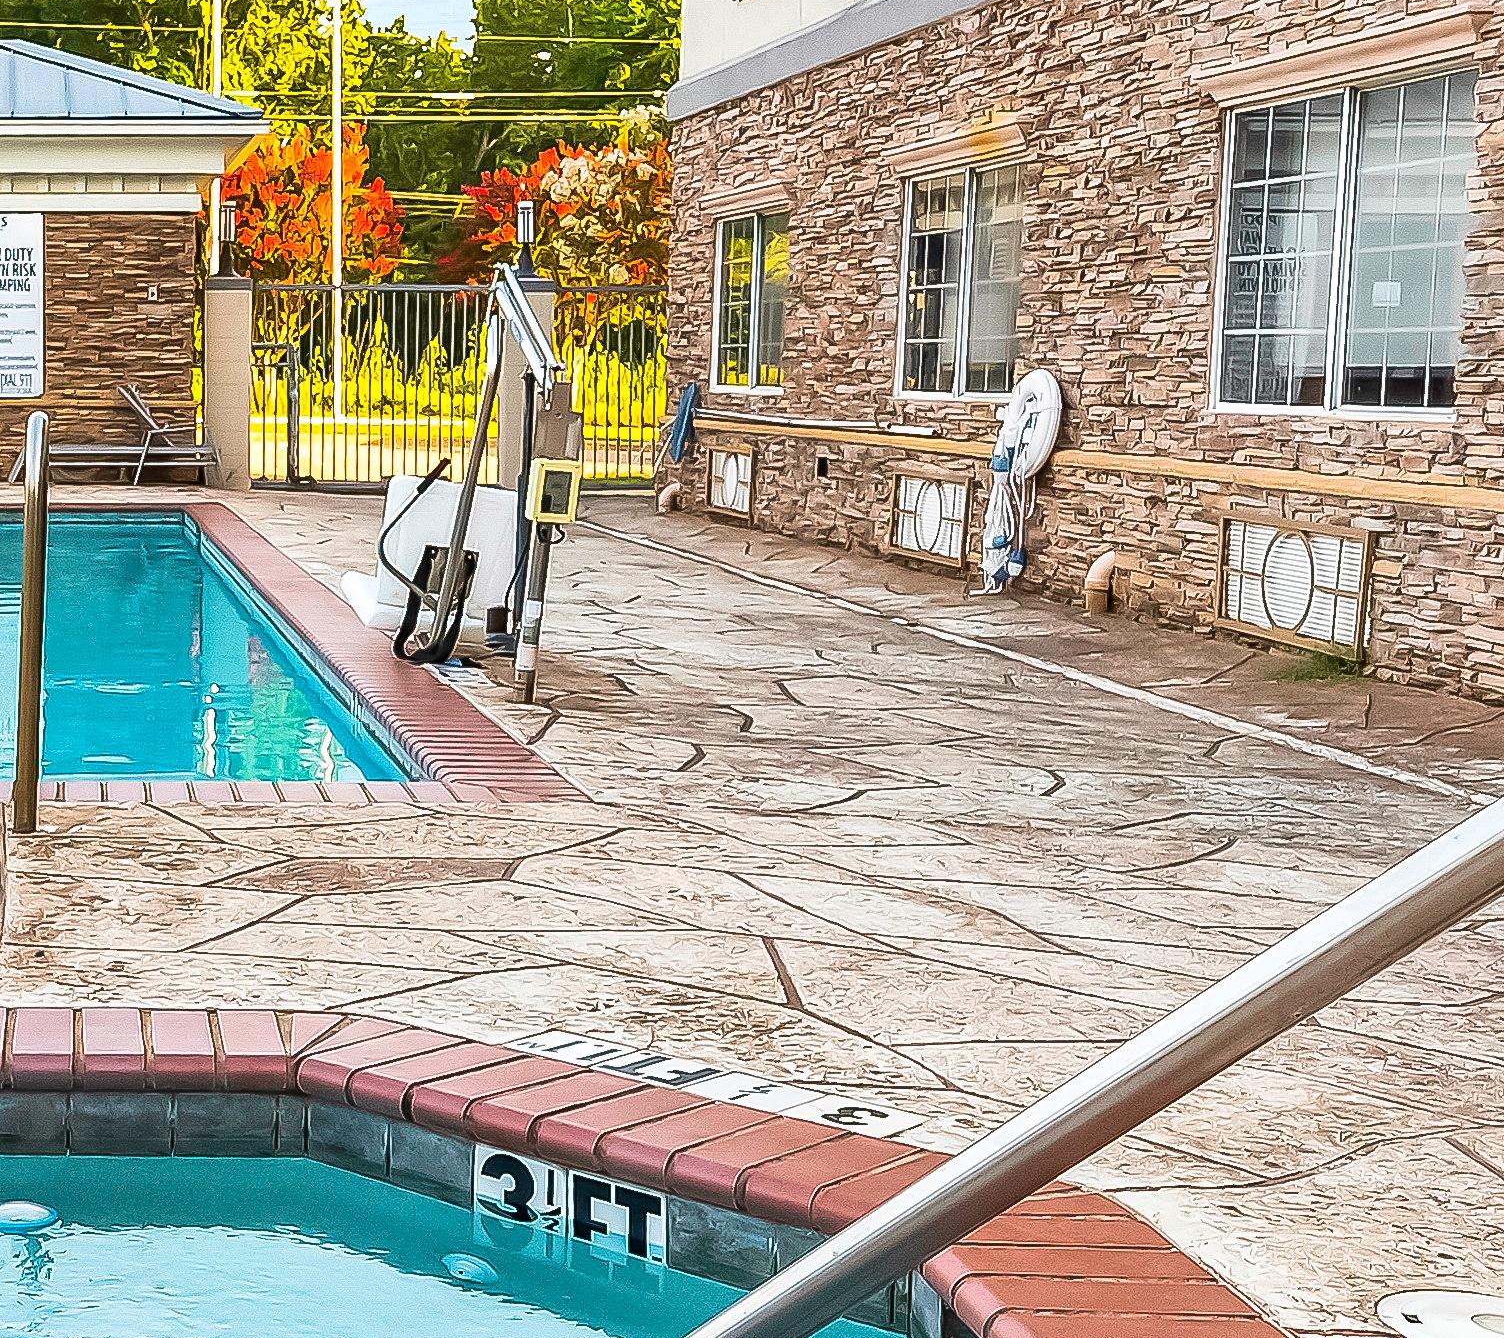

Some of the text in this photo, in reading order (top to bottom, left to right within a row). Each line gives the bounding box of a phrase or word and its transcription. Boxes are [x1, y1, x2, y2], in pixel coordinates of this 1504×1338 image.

[5, 248, 34, 262] DUTY
[12, 263, 37, 277] RISK
[821, 1106, 889, 1127] 3
[479, 1152, 537, 1223] 3
